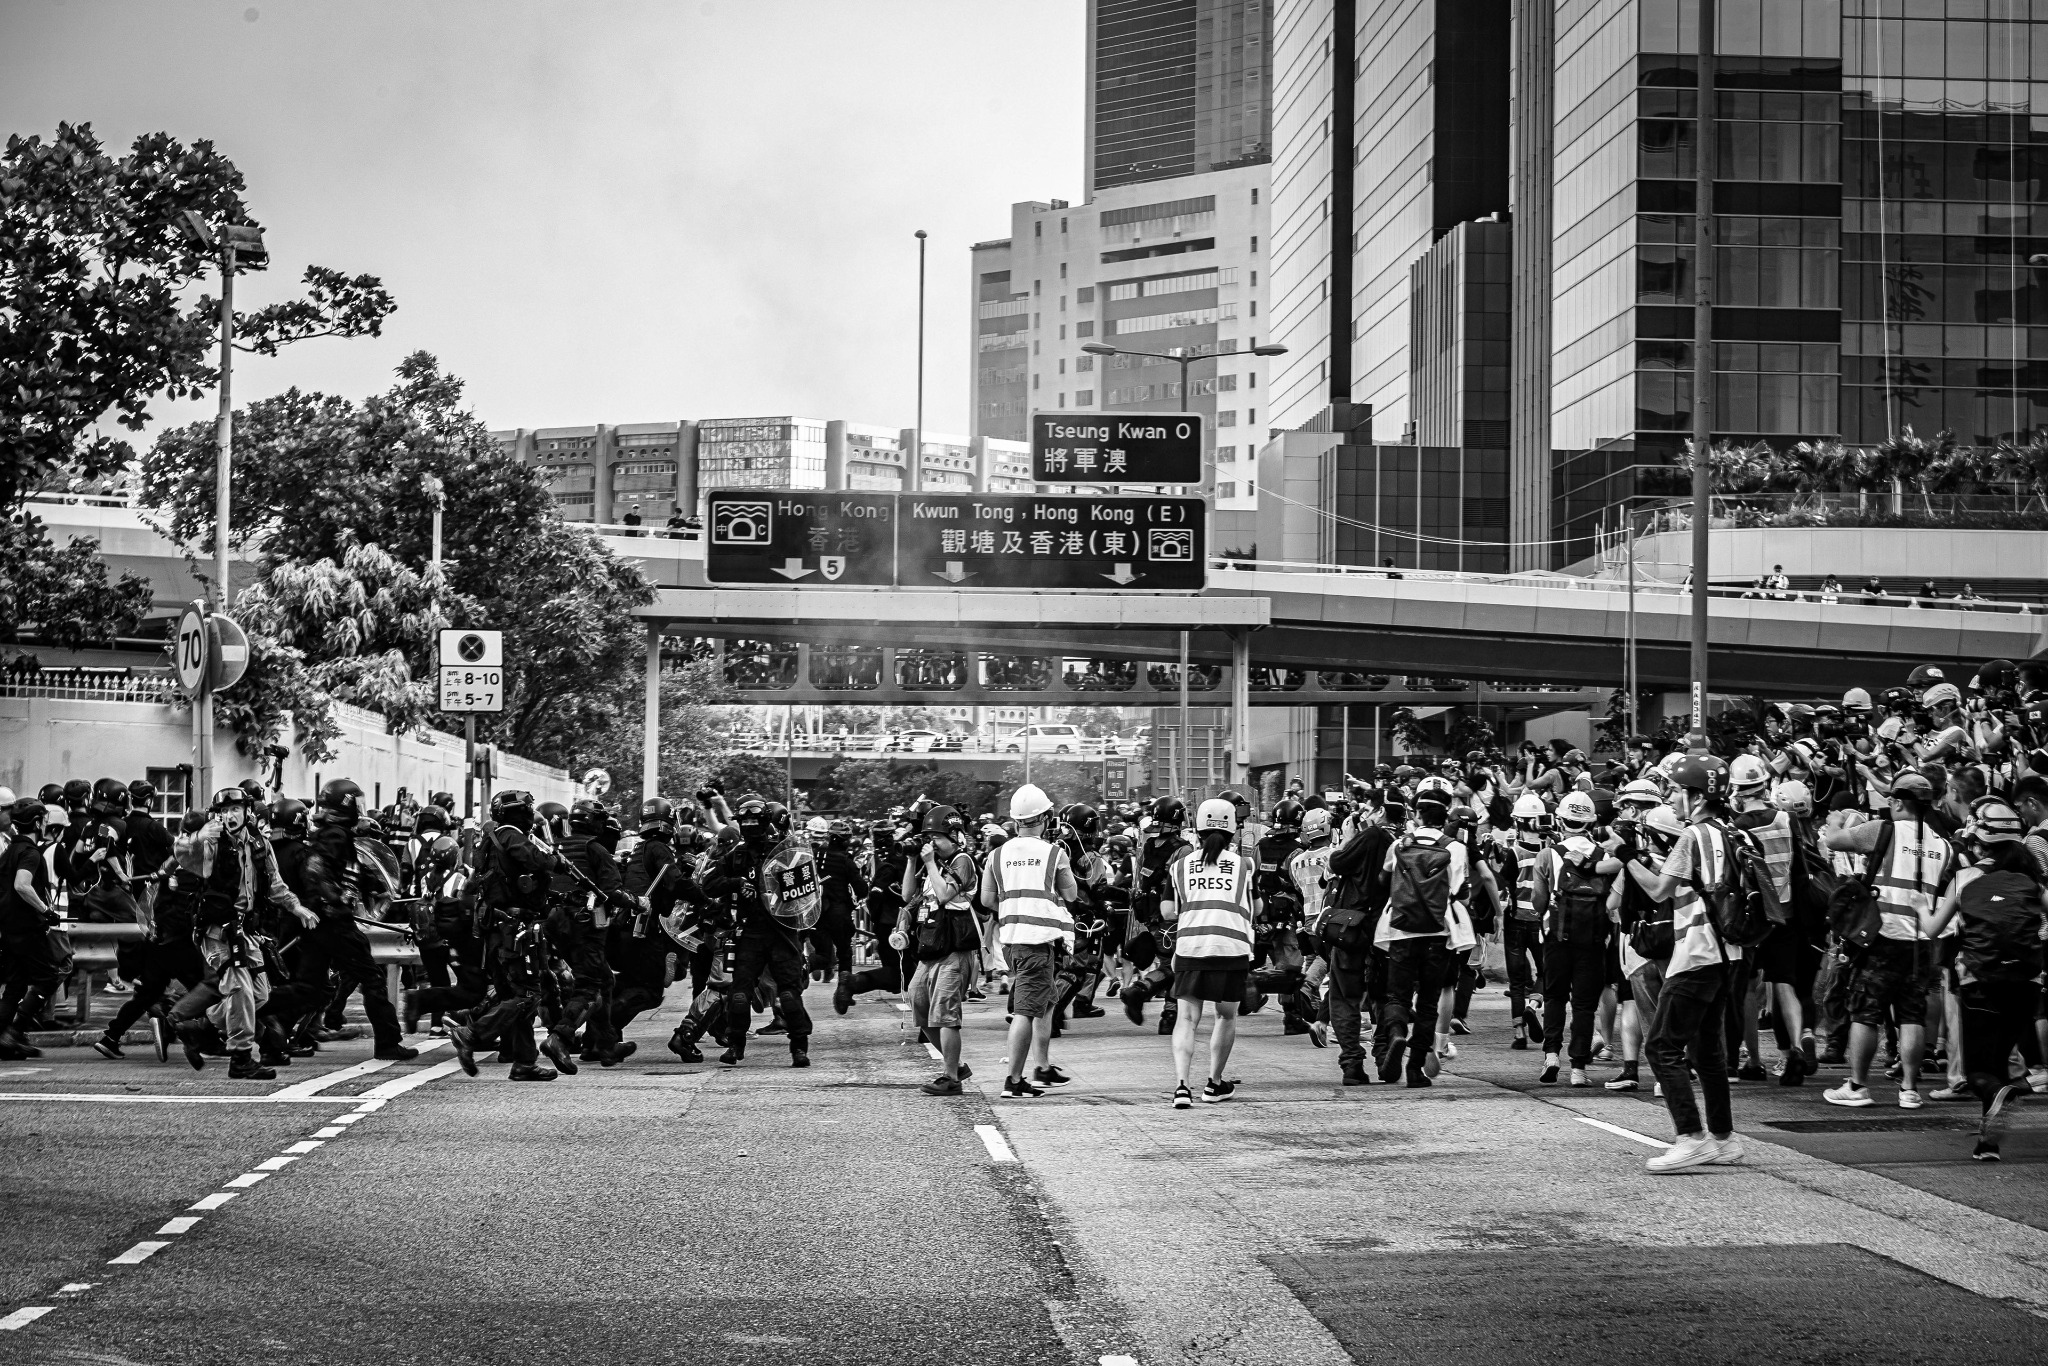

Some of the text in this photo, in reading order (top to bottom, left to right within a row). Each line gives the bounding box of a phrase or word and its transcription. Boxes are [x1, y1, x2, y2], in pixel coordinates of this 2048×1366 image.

[1045, 423, 1191, 442] Tseung Kwan O
[1044, 448, 1127, 473] 將軍澳
[778, 500, 889, 521] Hong Kong
[913, 503, 959, 518] Kwun
[1034, 504, 1078, 524] Hong
[1091, 505, 1134, 525] Kong
[757, 525, 766, 536] C
[808, 527, 860, 552] 香港
[826, 560, 838, 575] 5
[181, 629, 201, 671] 70
[465, 673, 499, 685] 8-10
[1189, 859, 1235, 875] 記者
[782, 881, 815, 901] POLICE
[1189, 878, 1233, 891] PRESS
